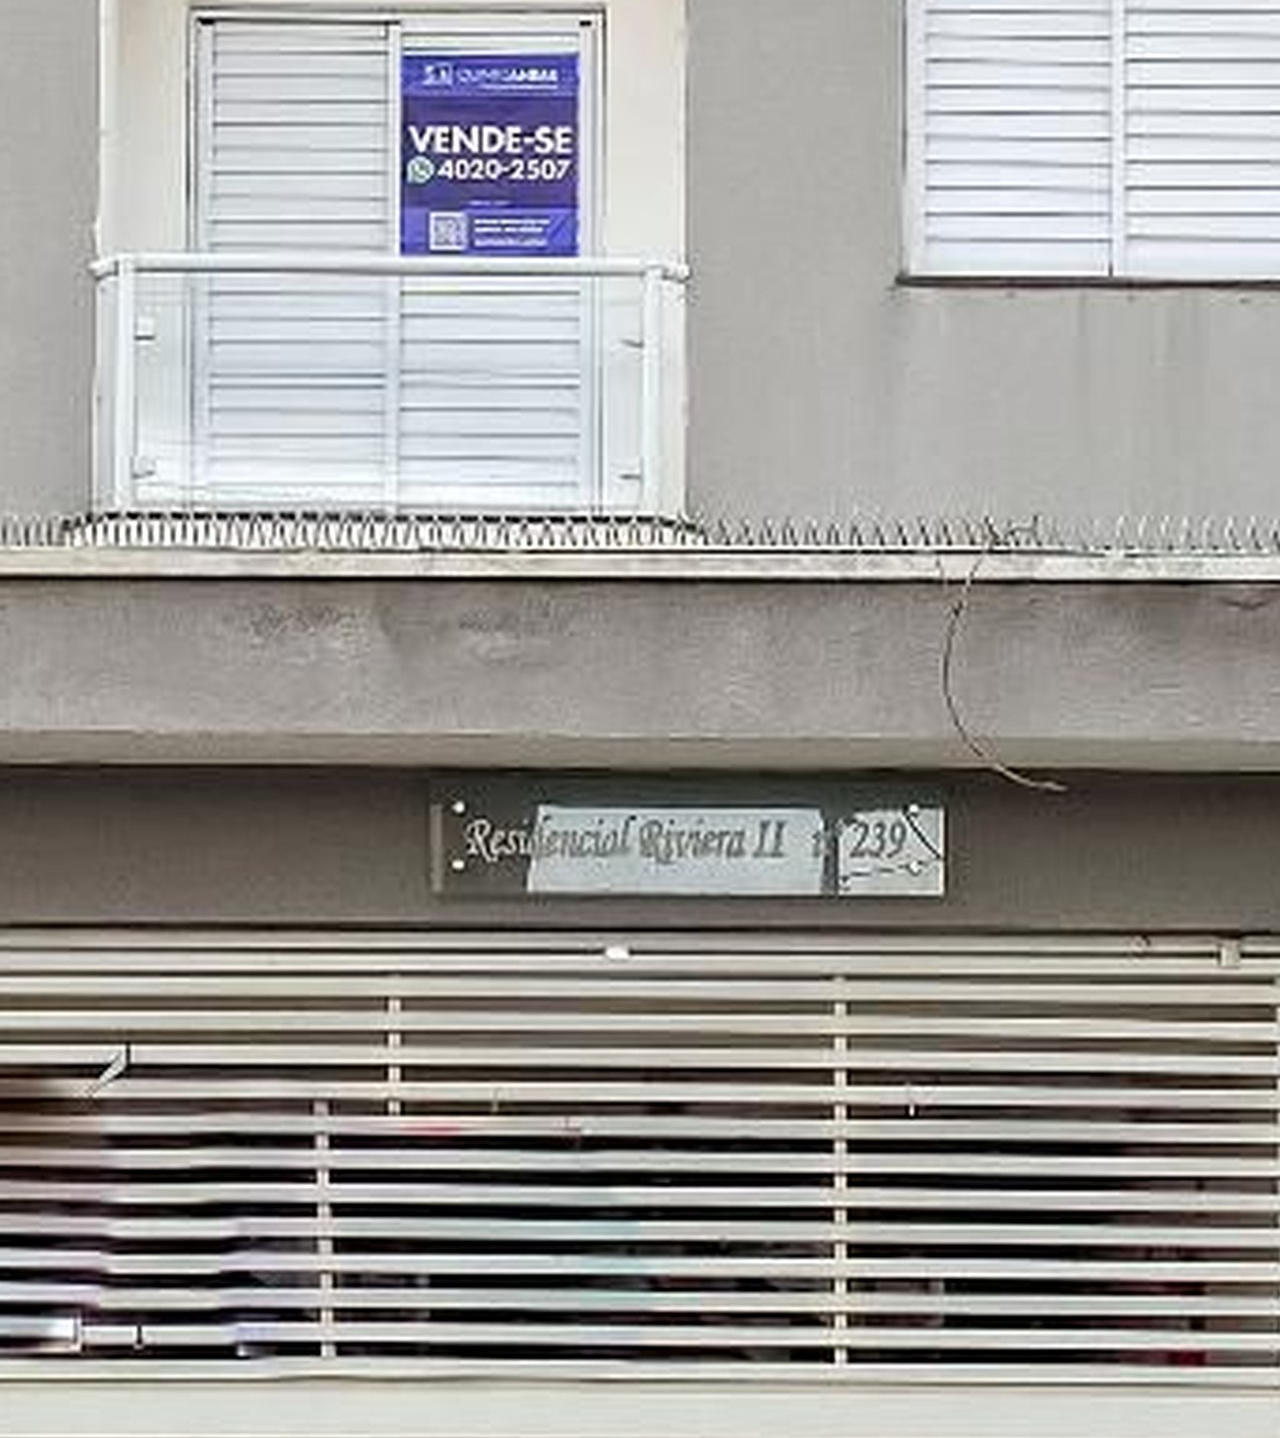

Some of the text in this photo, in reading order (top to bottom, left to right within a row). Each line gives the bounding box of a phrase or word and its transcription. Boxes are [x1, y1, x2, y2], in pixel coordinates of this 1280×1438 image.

[408, 126, 573, 154] VENDE-SE
[438, 160, 571, 181] 4020-2507
[465, 816, 636, 863] Residencial
[638, 817, 746, 865] Riviera
[752, 819, 787, 859] II
[849, 821, 908, 859] 239
